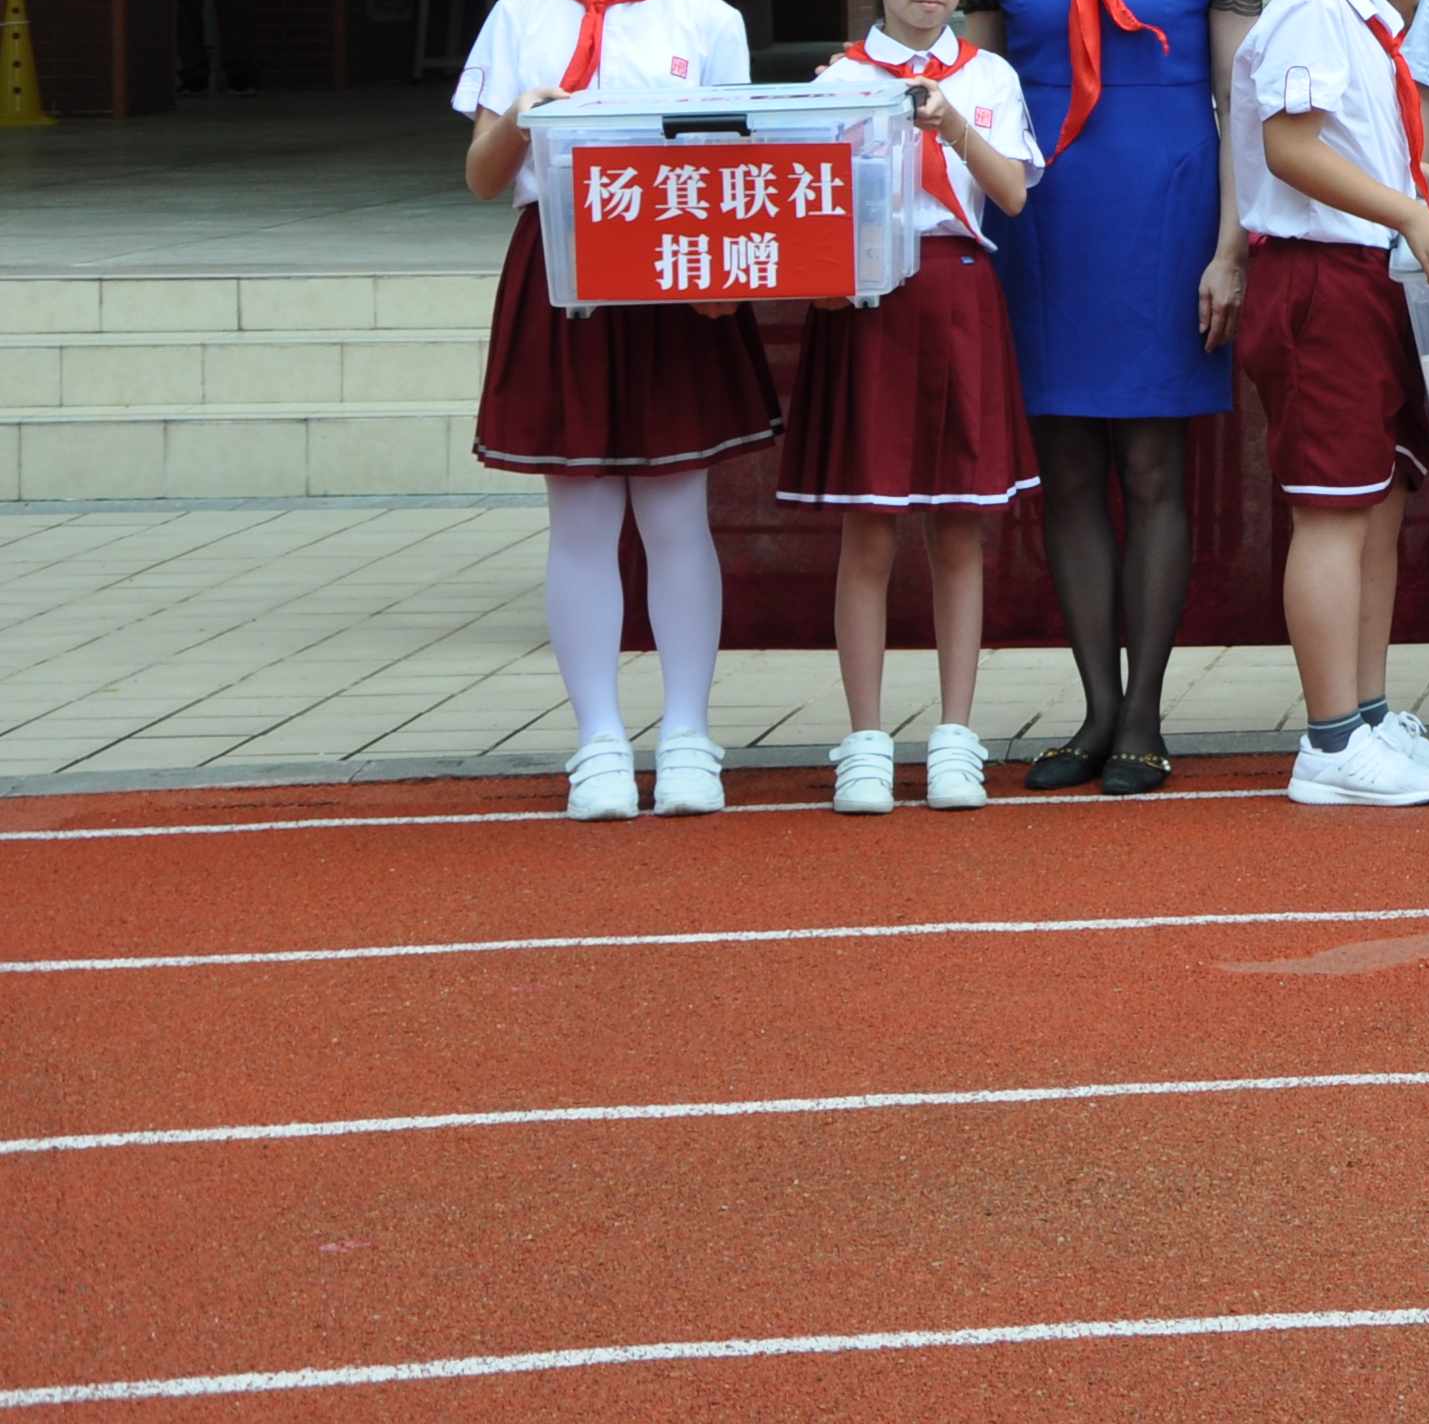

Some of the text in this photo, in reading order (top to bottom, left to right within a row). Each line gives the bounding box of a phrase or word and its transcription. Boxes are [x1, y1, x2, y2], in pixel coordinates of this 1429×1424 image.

[583, 162, 846, 224] 杨箕联社
[654, 231, 779, 291] 捐赠
